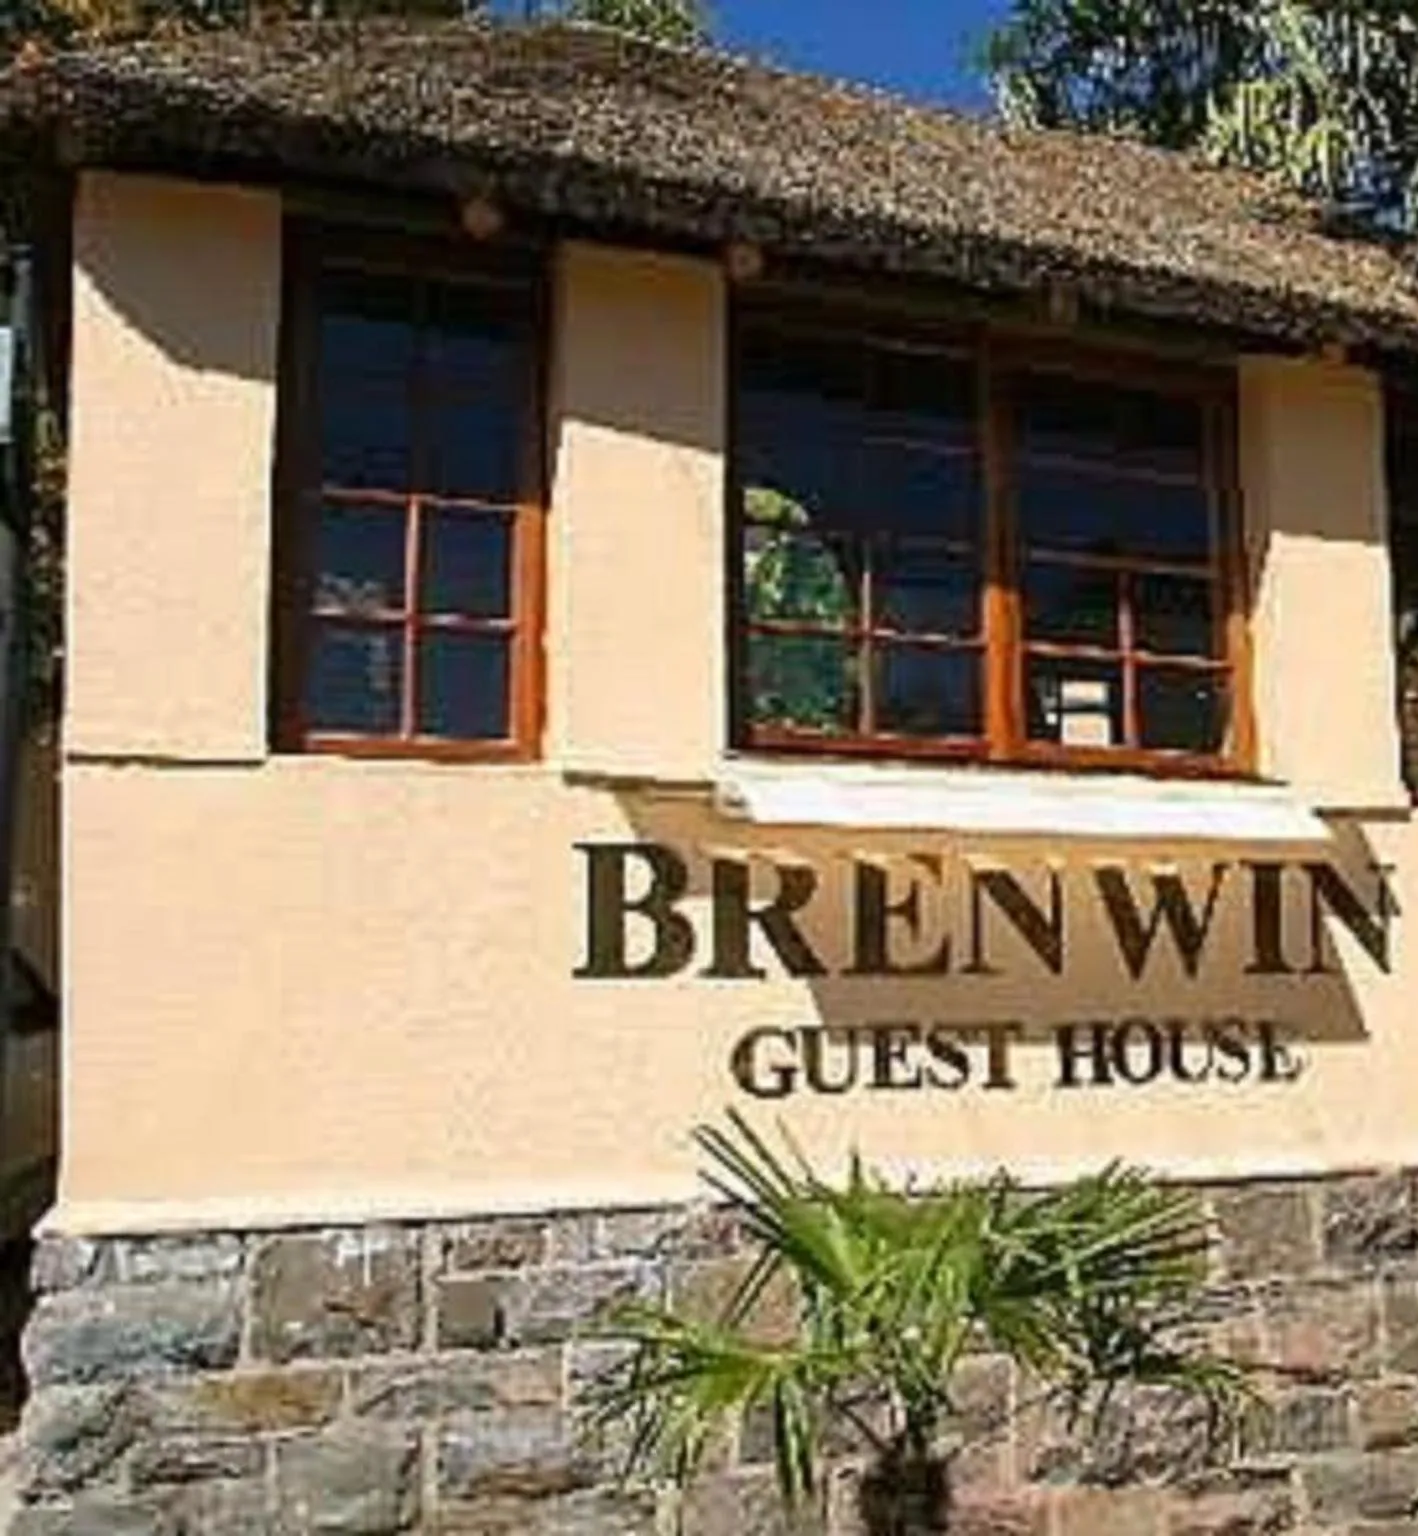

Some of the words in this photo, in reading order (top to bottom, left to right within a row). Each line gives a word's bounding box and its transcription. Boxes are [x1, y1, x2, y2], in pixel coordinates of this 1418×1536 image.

[572, 842, 1400, 980] BRENWIN
[730, 1022, 1020, 1100] GUEST
[1055, 1017, 1304, 1087] HOUSE
